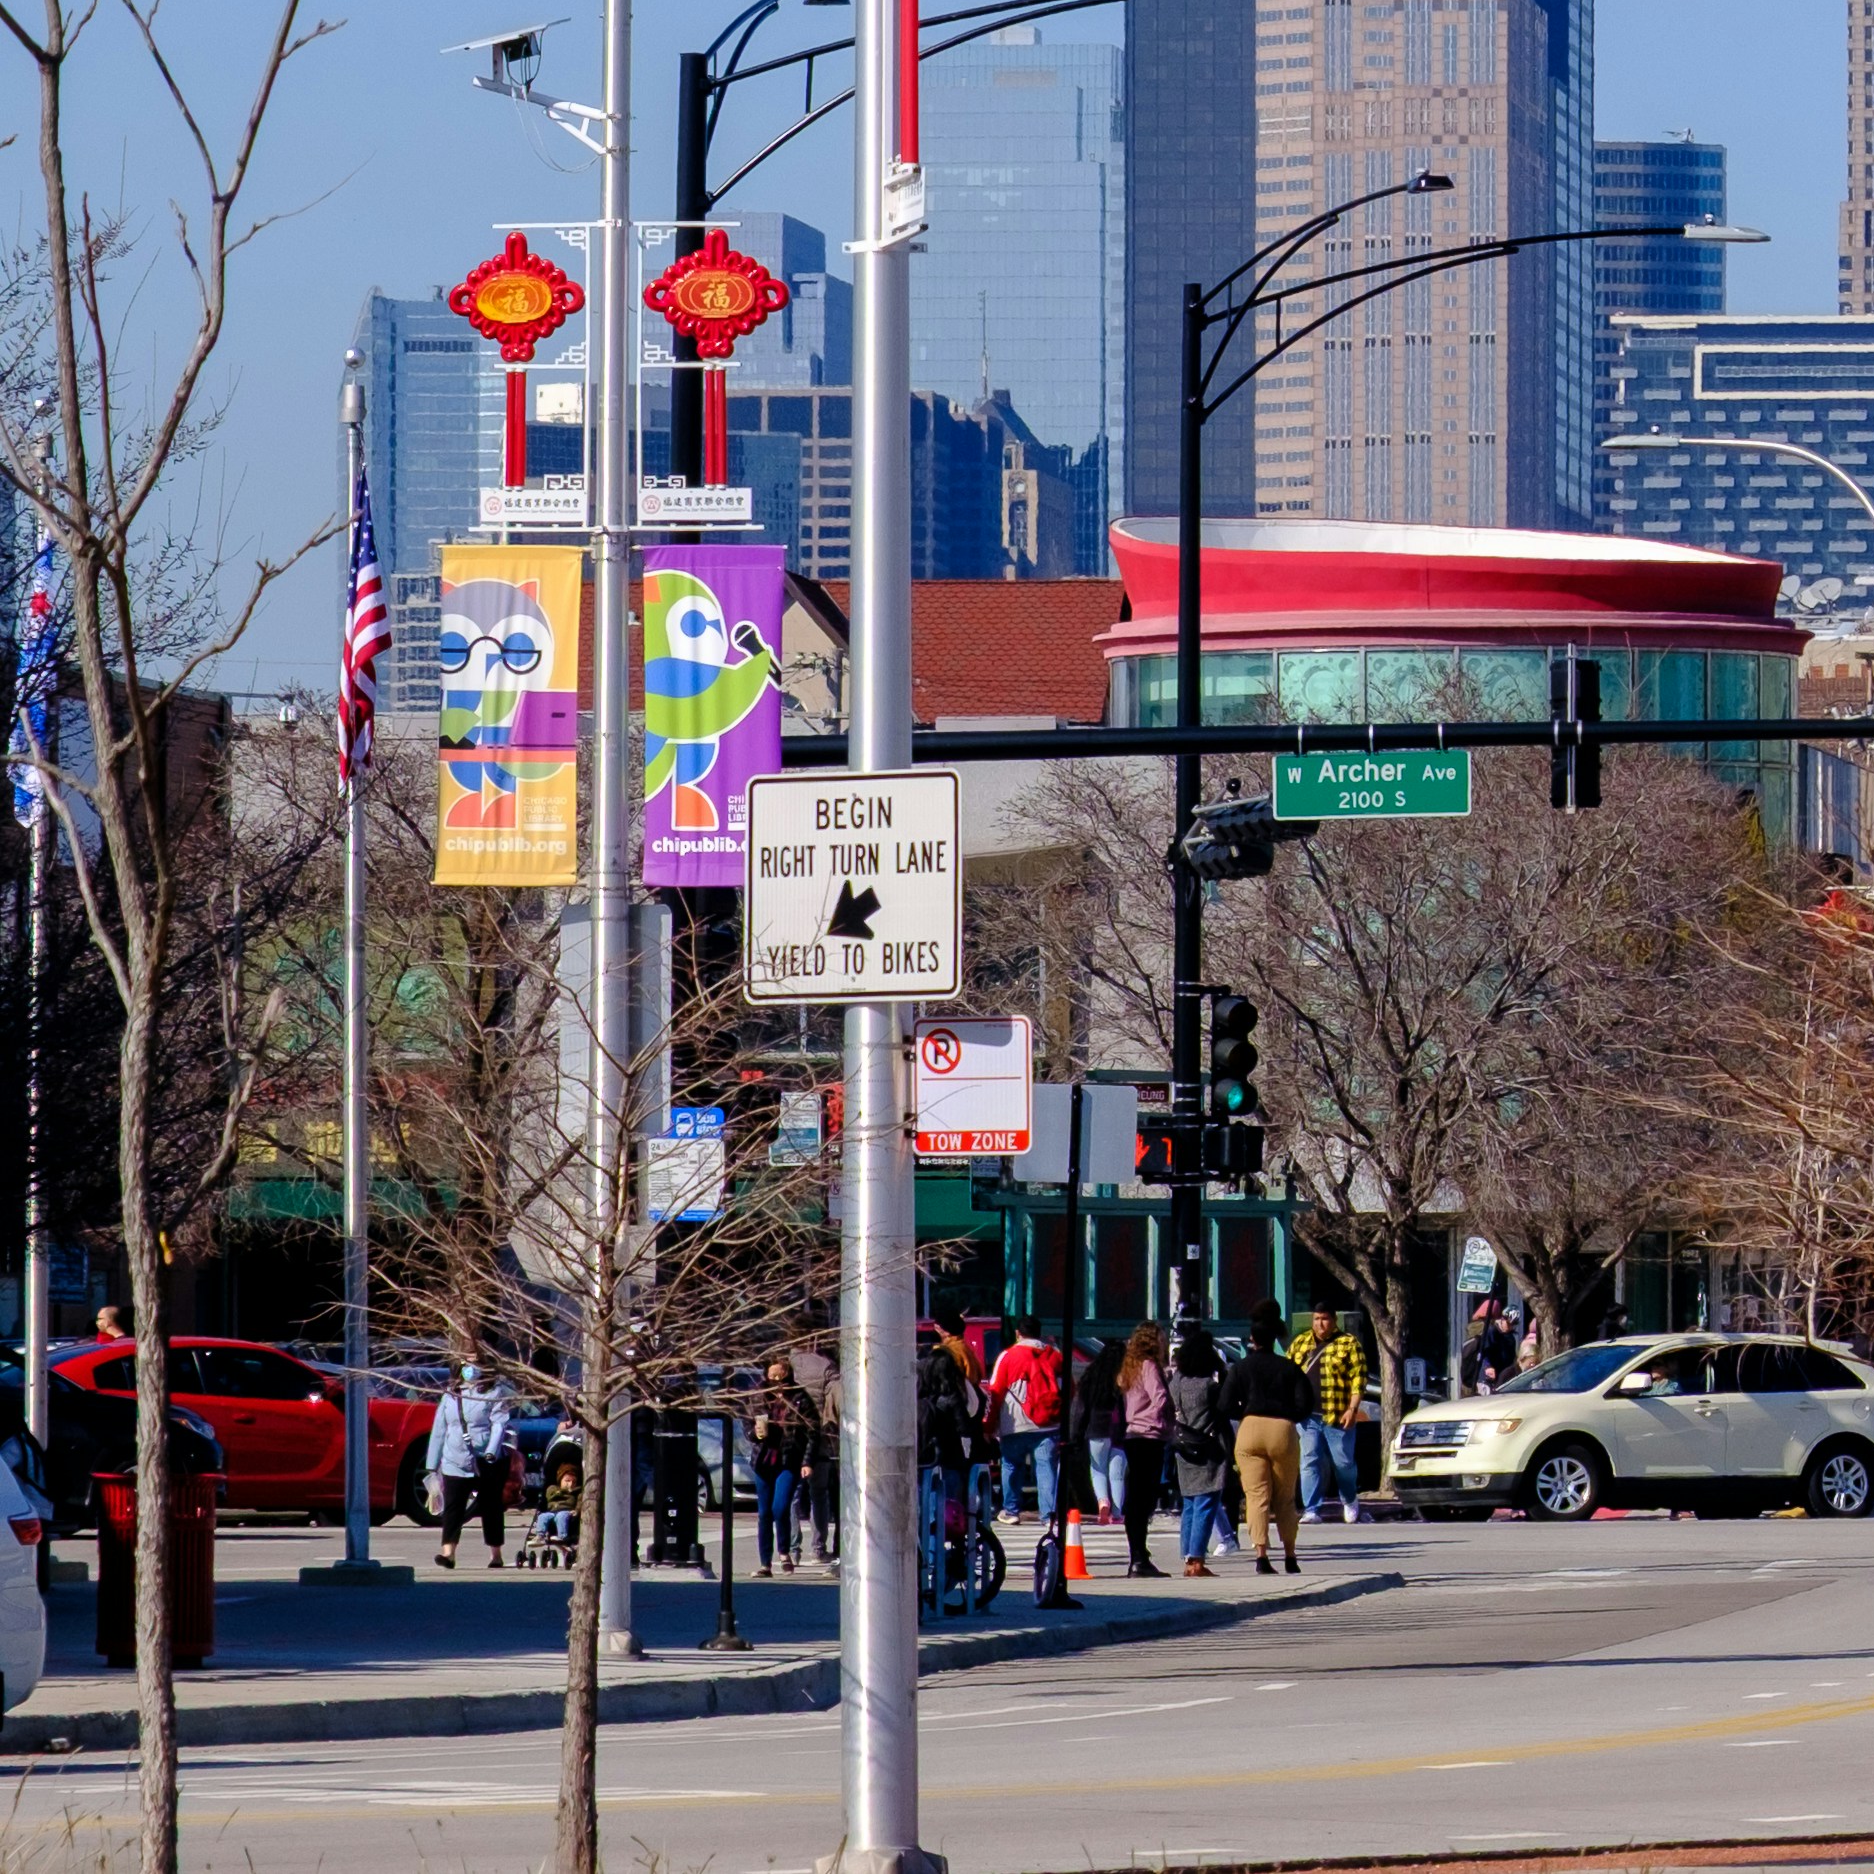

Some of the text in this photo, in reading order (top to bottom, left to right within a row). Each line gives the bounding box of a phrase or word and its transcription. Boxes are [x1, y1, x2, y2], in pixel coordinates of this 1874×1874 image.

[500, 288, 529, 314] 福
[701, 283, 730, 309] 福
[1287, 758, 1457, 784] W Archer Ave
[523, 795, 568, 806] CHICAGO
[523, 805, 558, 814] PUBLIC
[1338, 790, 1406, 809] 2100 S
[523, 813, 563, 823] LIBRARY
[815, 796, 893, 831] BEGIN
[445, 836, 567, 856] chipublib.org
[652, 836, 746, 856] chipublib.
[760, 840, 947, 878] RIGHT TURN LANE
[767, 940, 939, 977] YIELD TO BIKES
[927, 1131, 1018, 1151] TOW ZONE
